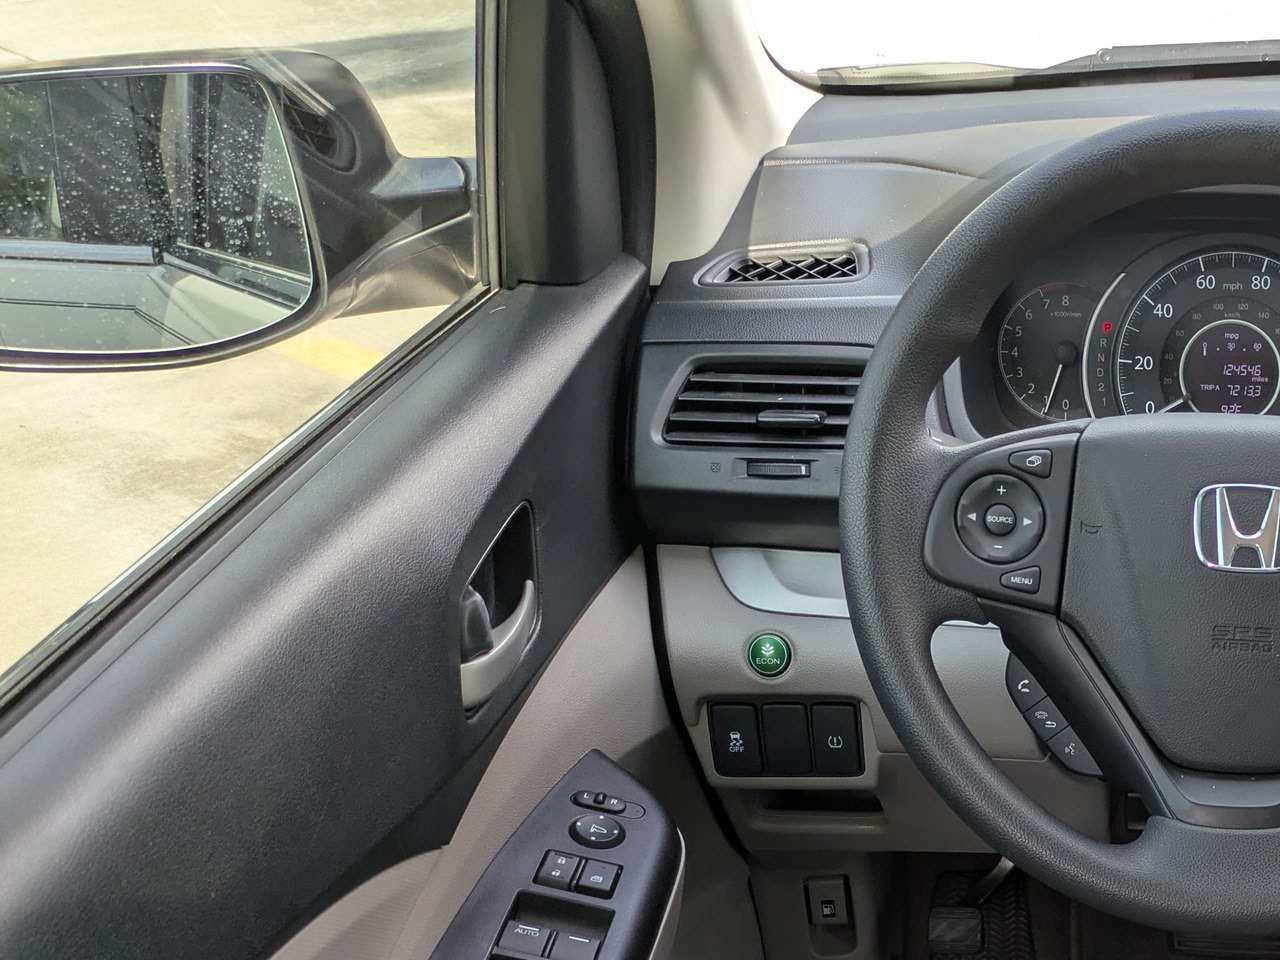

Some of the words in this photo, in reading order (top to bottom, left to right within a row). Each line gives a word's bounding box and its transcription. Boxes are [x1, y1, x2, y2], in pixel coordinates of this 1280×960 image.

[1196, 274, 1216, 290] 60
[1223, 282, 1243, 292] mph
[1251, 274, 1271, 290] 80
[1042, 299, 1050, 309] 7
[1062, 295, 1070, 306] 8
[1025, 309, 1033, 320] 6
[1153, 303, 1173, 319] 40
[1015, 326, 1023, 337] 5
[1224, 332, 1240, 340] mpg
[1100, 338, 1107, 348] R
[1011, 346, 1019, 357] 4
[1097, 353, 1105, 362] N
[1134, 355, 1154, 370] 20
[1016, 367, 1023, 378] 3
[1223, 364, 1262, 376] 124546
[1028, 383, 1036, 394] 2
[1098, 382, 1105, 392] 2
[1062, 399, 1070, 410] 0
[1145, 401, 1155, 415] 0
[986, 514, 1013, 524] SOURCE
[1010, 576, 1033, 585] MENU
[1211, 625, 1273, 642] SRS
[1210, 642, 1274, 653] AIRBAG
[755, 657, 781, 665] ECON
[729, 745, 745, 753] OFF
[514, 928, 540, 937] AUTO
